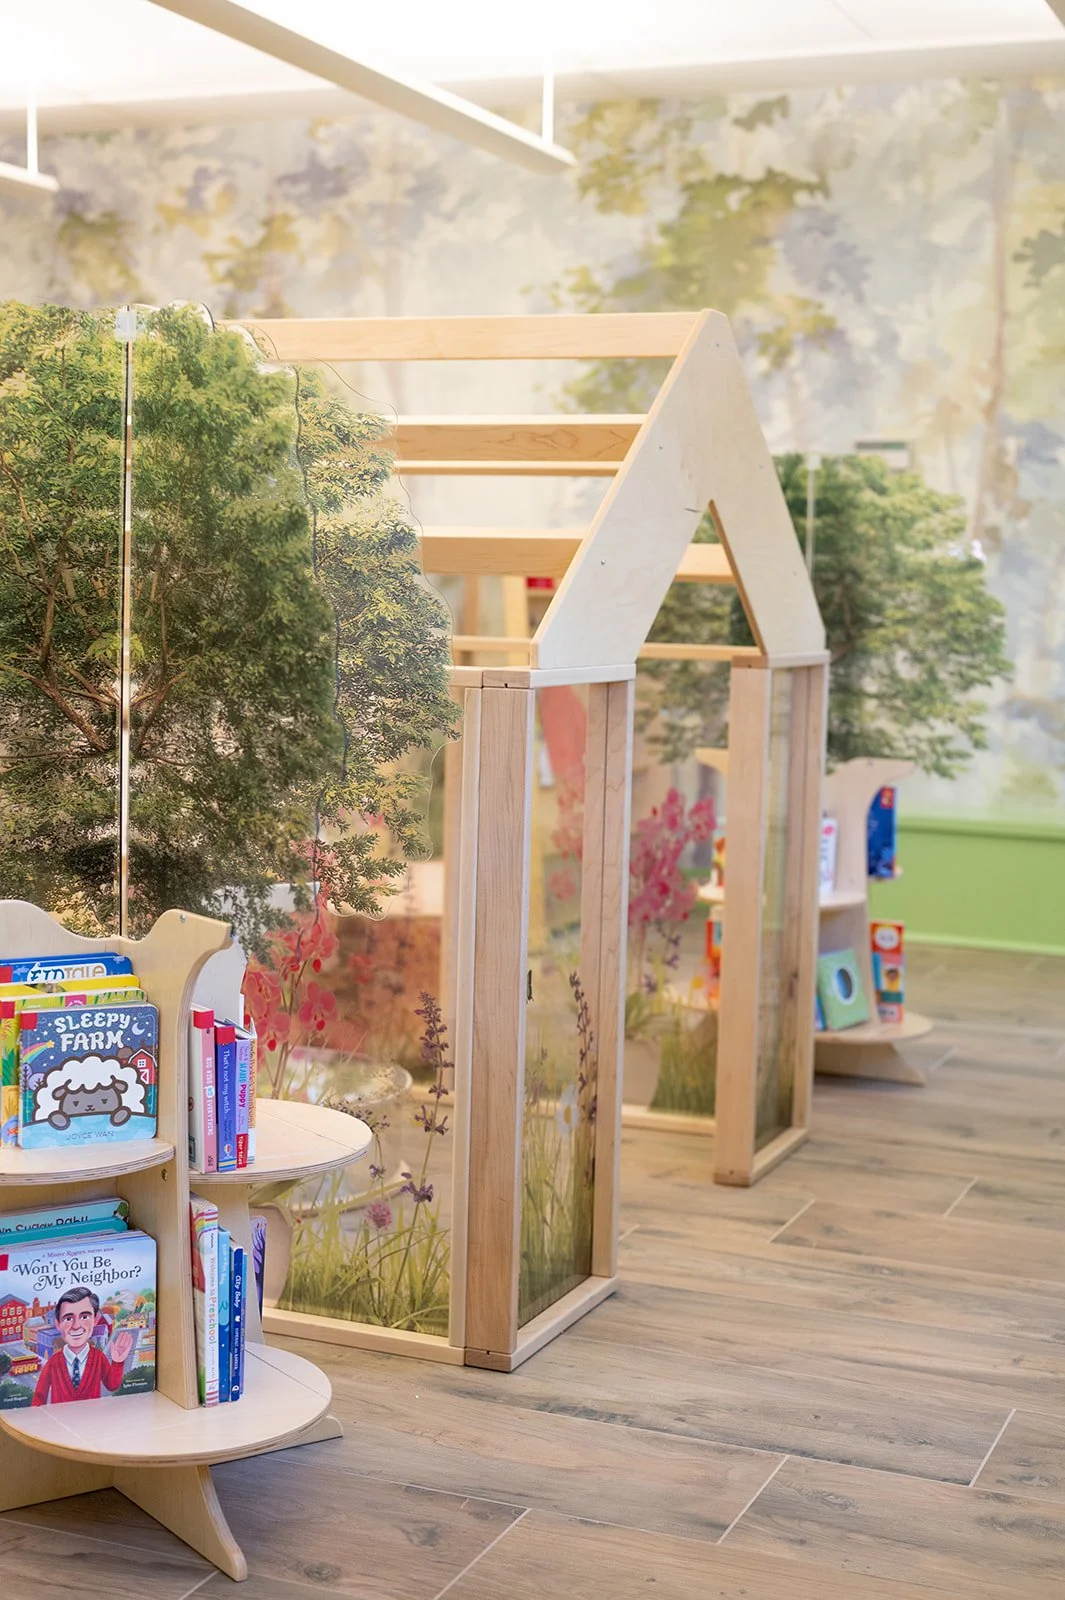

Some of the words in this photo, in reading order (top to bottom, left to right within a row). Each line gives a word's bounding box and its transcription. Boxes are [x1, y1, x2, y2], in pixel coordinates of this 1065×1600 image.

[54, 1012, 131, 1033] SLEEPY
[60, 1030, 124, 1052] FARM
[221, 1083, 229, 1095] my
[66, 1131, 92, 1140] JOYCE
[95, 1130, 114, 1138] WAN
[13, 1259, 58, 1276] Won't
[63, 1257, 88, 1272] You
[93, 1256, 112, 1269] Be
[33, 1274, 66, 1291] My
[70, 1265, 142, 1286] Neighbor?
[208, 1297, 217, 1344] Preschool
